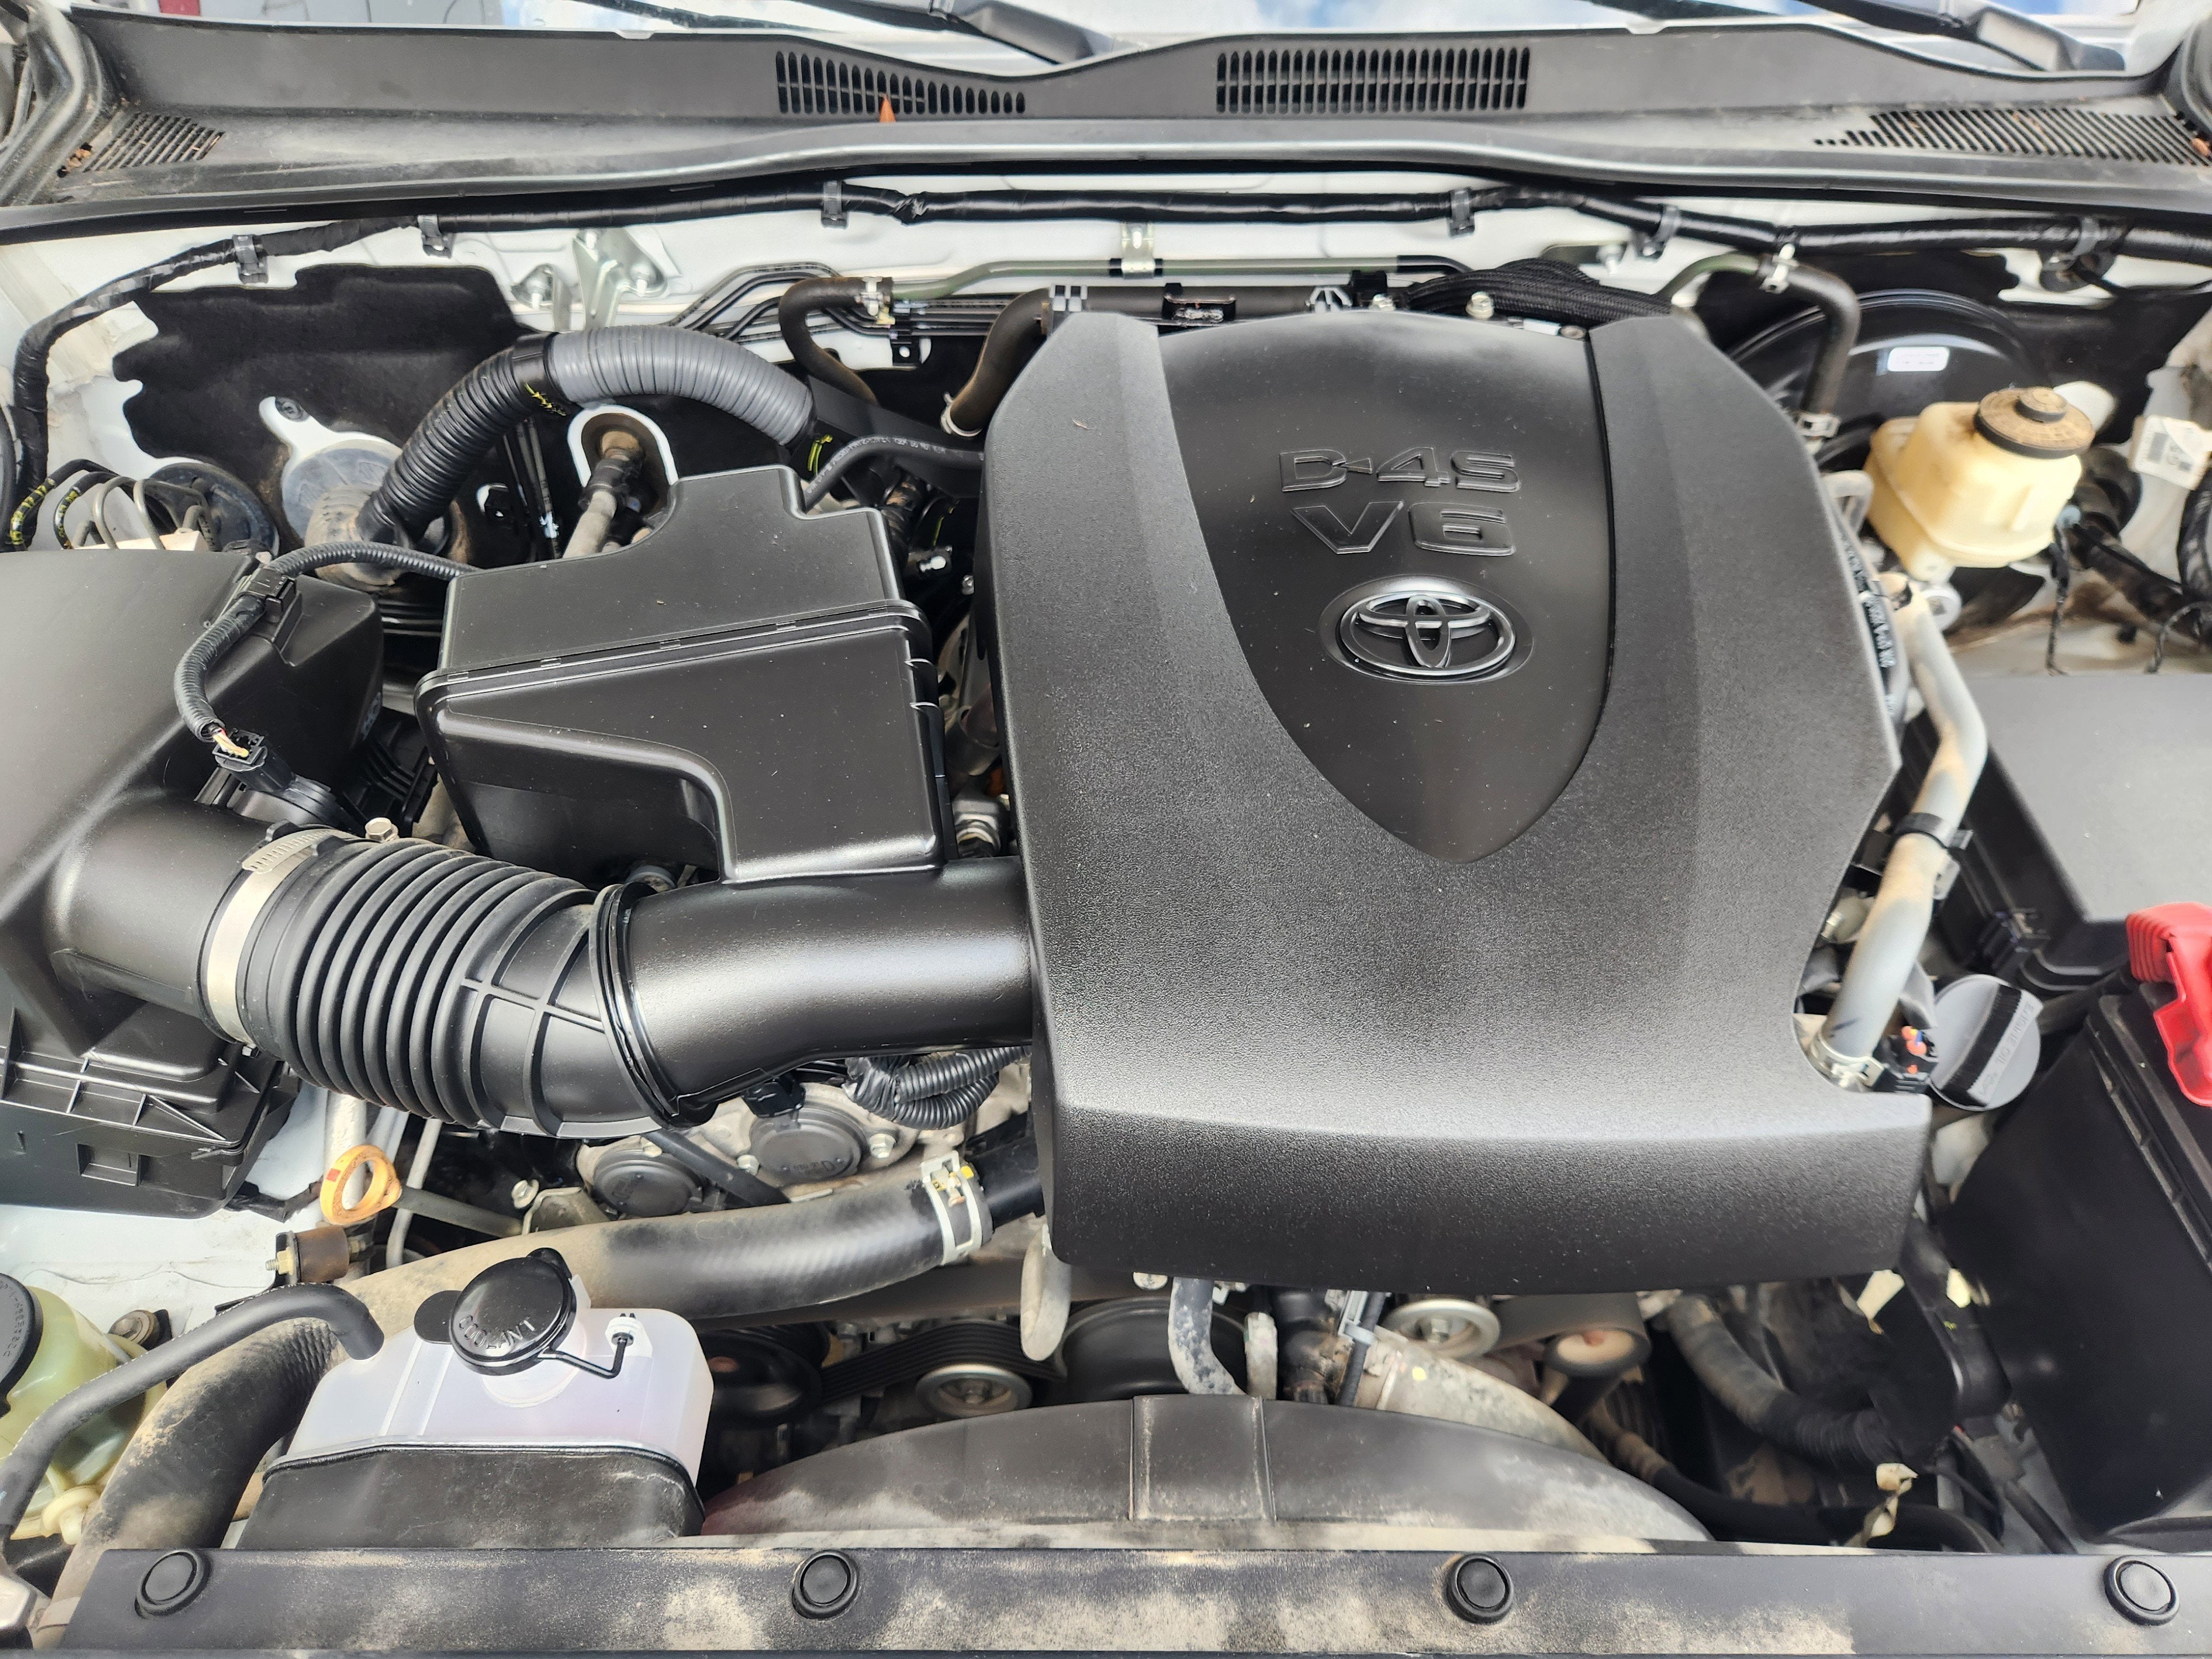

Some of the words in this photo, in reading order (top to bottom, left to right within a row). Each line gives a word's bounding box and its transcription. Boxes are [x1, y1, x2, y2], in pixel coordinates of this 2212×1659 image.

[1279, 447, 1521, 492] D-4S
[1290, 500, 1516, 556] V6
[459, 1314, 535, 1349] COOLANT
